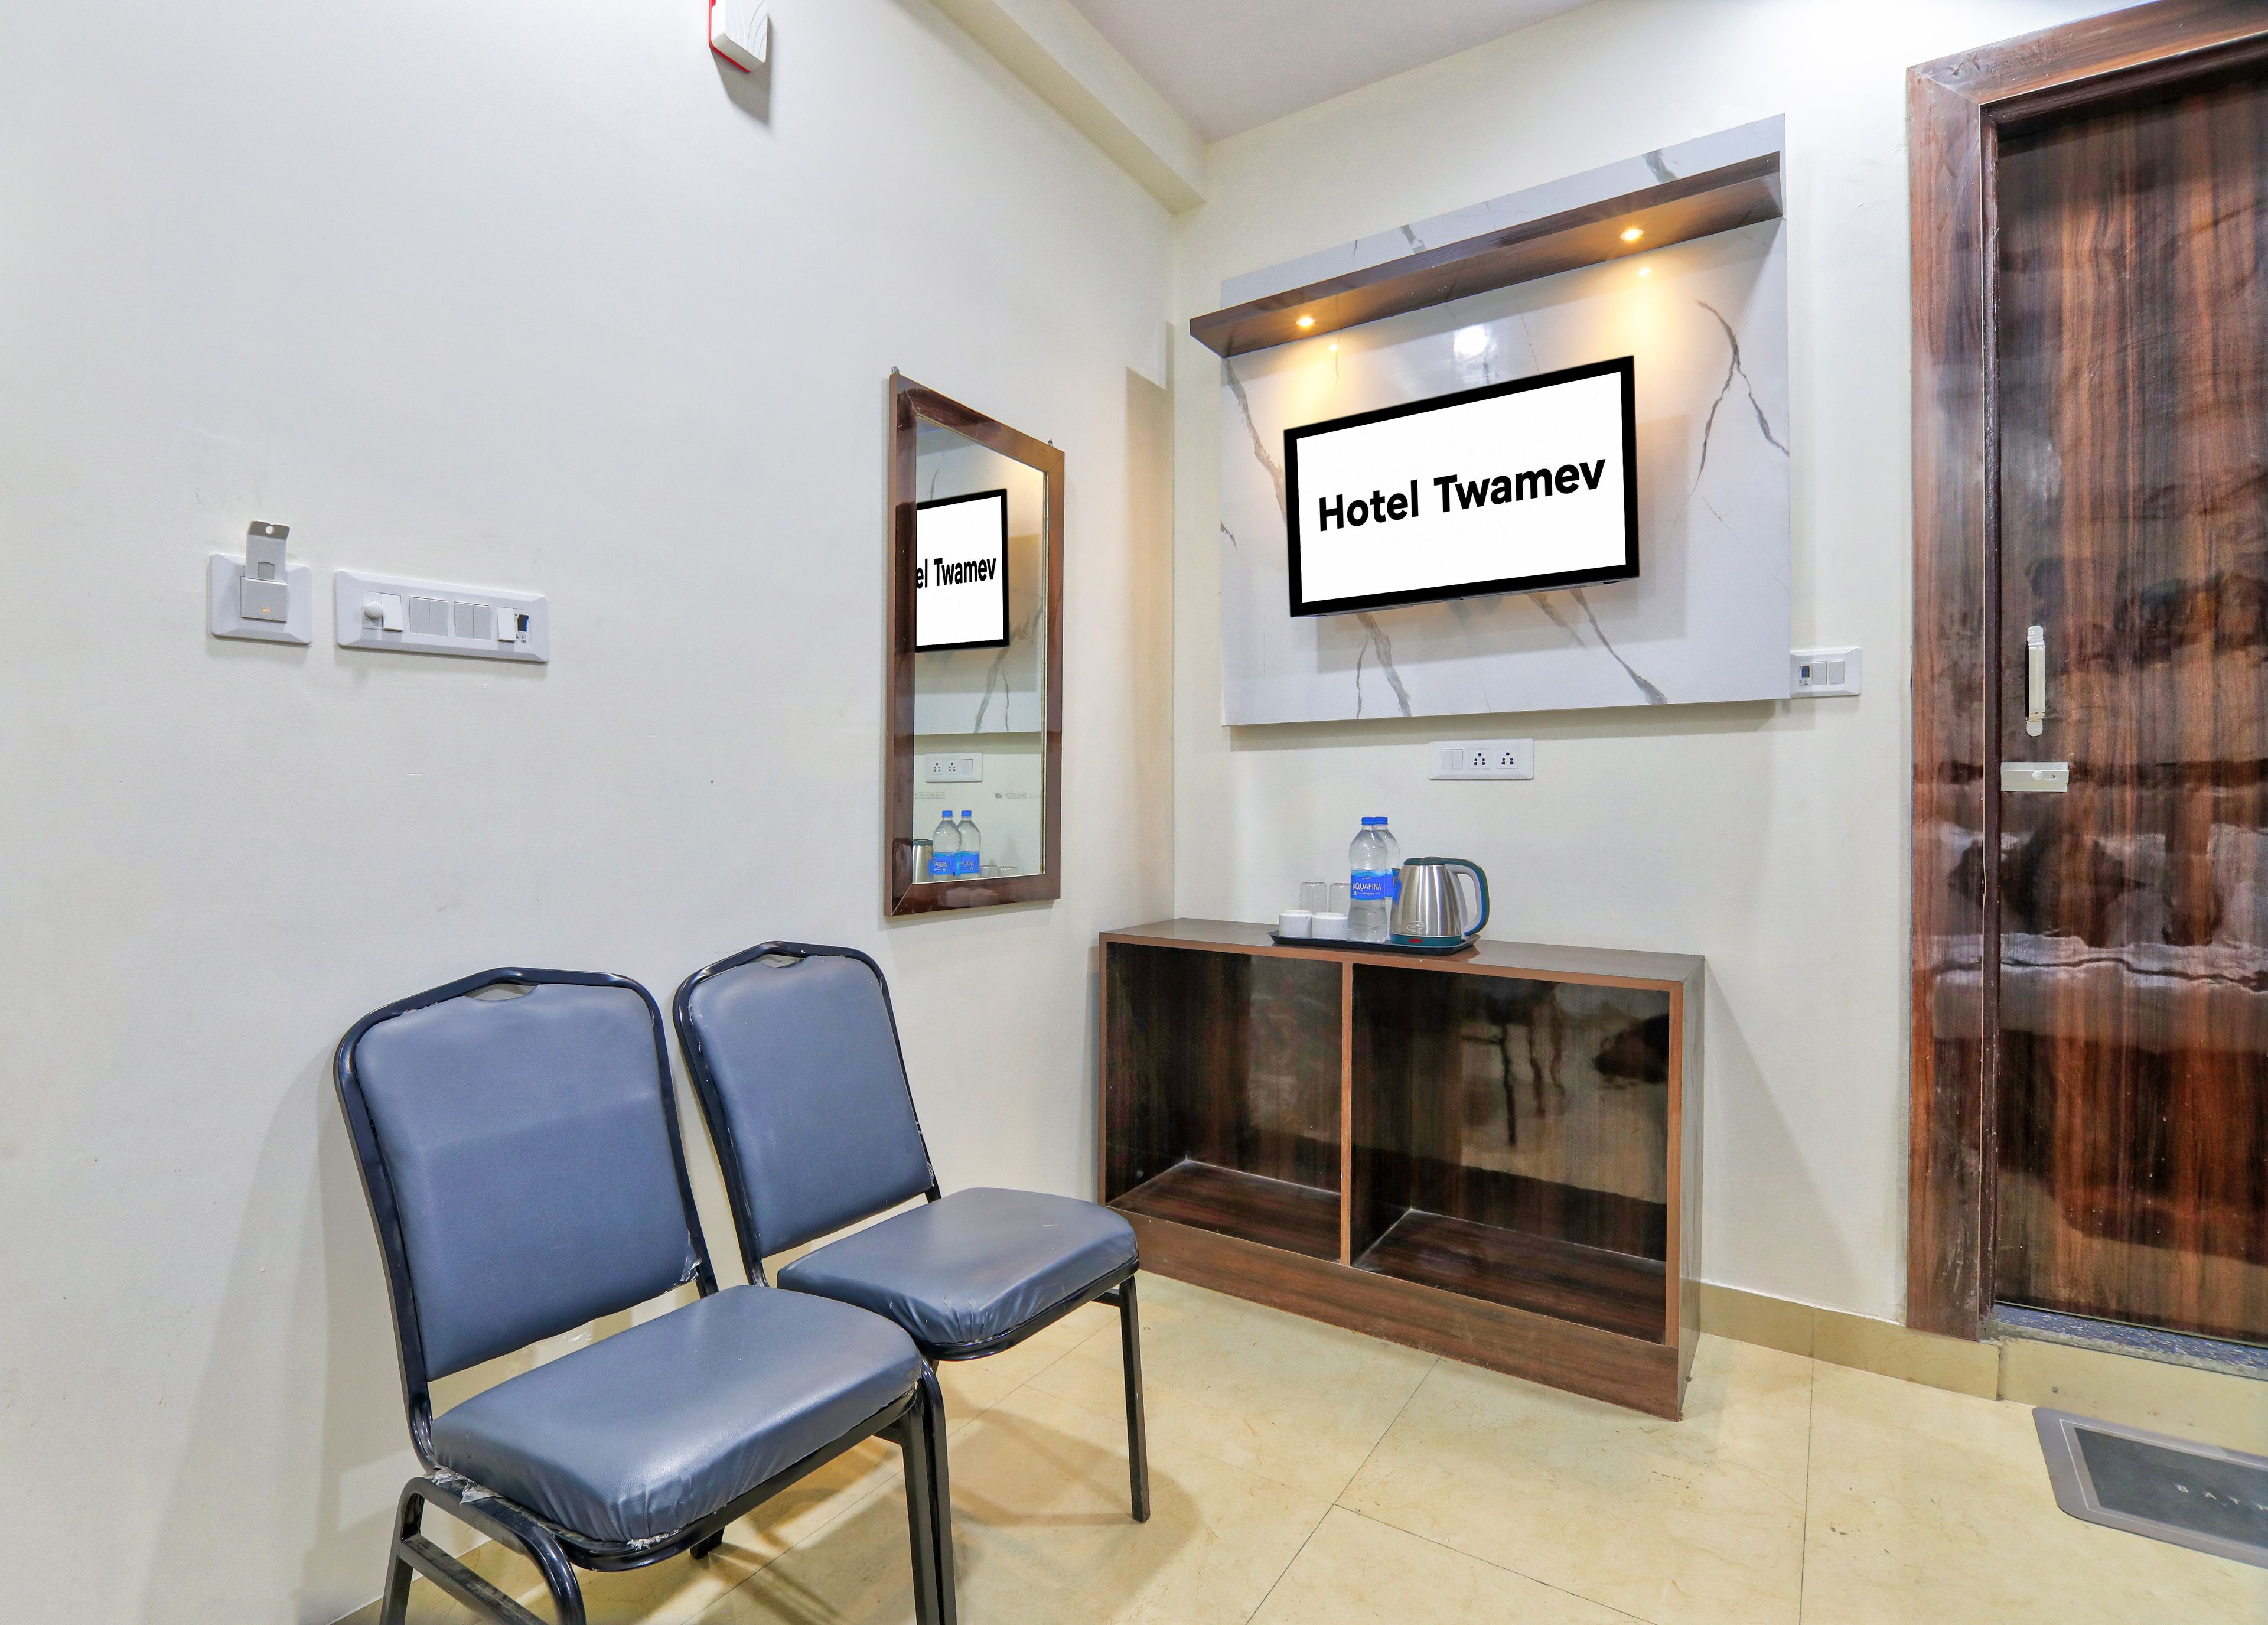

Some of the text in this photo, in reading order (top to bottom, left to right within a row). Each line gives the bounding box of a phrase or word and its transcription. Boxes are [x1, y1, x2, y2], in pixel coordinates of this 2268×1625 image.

[1319, 458, 1606, 532] Hotel Twamev
[934, 558, 996, 587] Twamev
[1353, 882, 1381, 891] AQUAFINA
